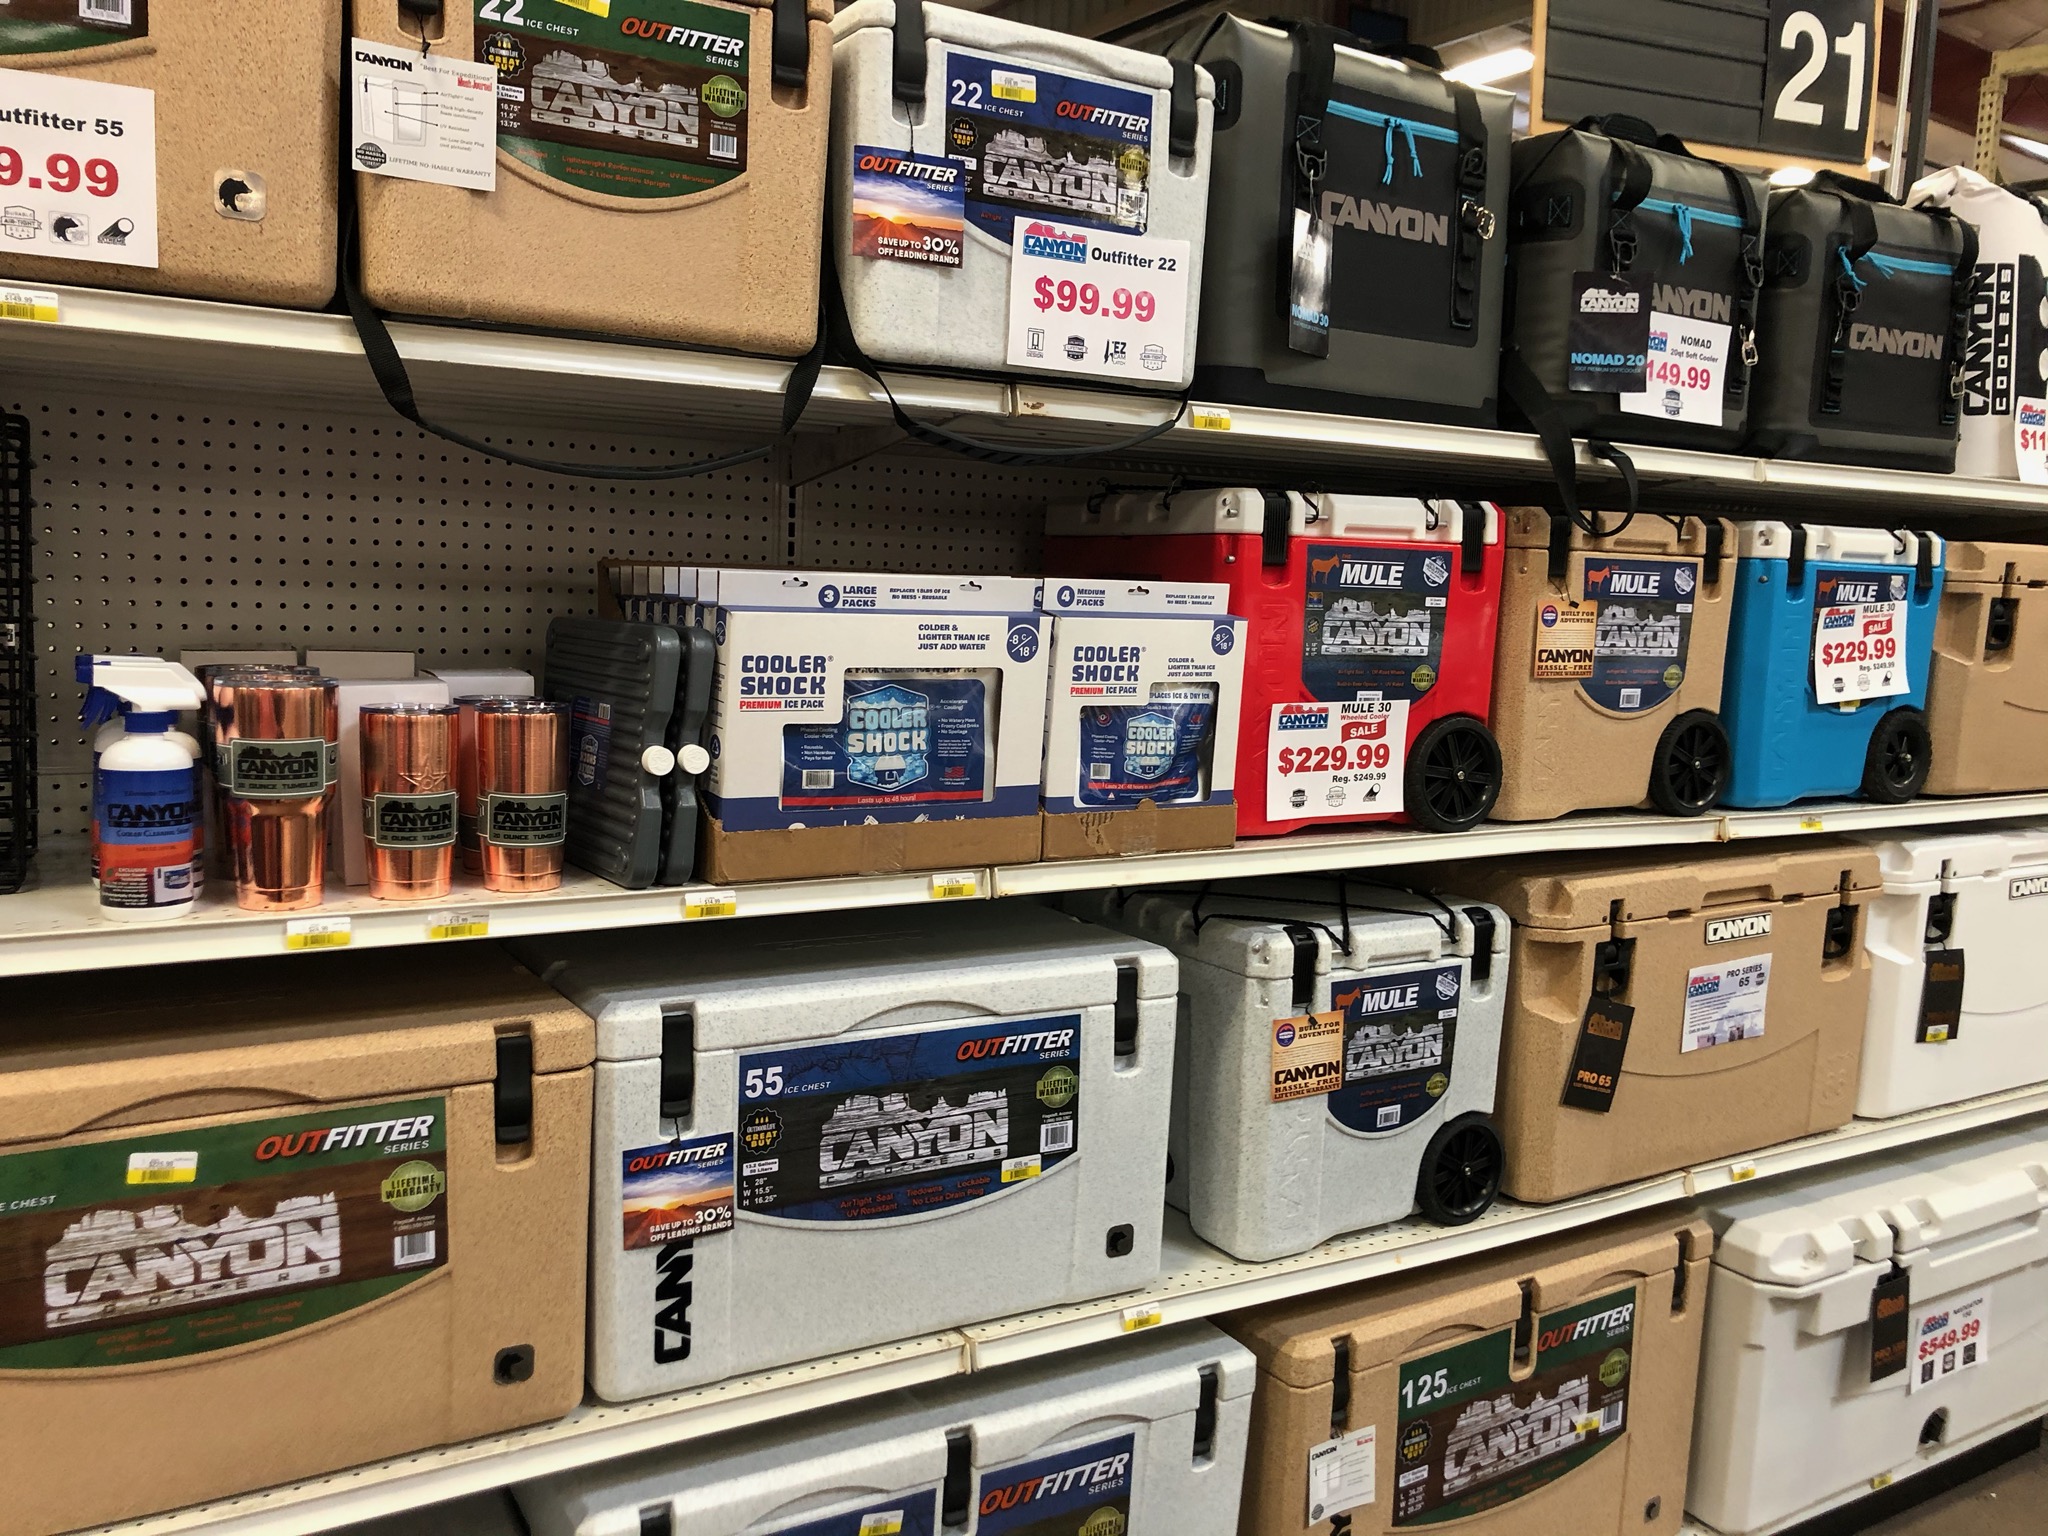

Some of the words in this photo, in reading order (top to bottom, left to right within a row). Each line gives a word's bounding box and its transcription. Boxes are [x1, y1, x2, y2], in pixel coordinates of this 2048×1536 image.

[526, 19, 542, 29] ICE
[546, 23, 579, 36] CHEST
[621, 18, 744, 57] OUTFITTER
[356, 51, 412, 71] CANYON
[706, 55, 739, 68] SERIES
[1773, 10, 1866, 132] 21
[709, 86, 740, 97] LIFETIME
[952, 79, 983, 109] 22
[531, 77, 698, 134] CANYON
[704, 93, 745, 108] WARRANTY
[984, 104, 997, 114] ICE
[999, 107, 1023, 117] CHEST
[1056, 100, 1149, 132] OUTFITTER
[95, 119, 123, 136] 55
[1122, 131, 1148, 142] SERIES
[860, 155, 958, 183] OUTFITTER
[984, 153, 1117, 204] CANYON
[927, 182, 953, 193] SERIES
[1321, 191, 1448, 246] CANYON
[878, 236, 898, 246] SAVE
[899, 239, 909, 248] UP
[911, 240, 921, 249] TO
[922, 236, 958, 255] 30%
[1025, 235, 1086, 257] CANYON
[878, 247, 893, 257] OFF
[894, 249, 928, 261] LEADING
[929, 254, 959, 265] BRANDS
[1092, 248, 1153, 268] Outfitter
[1158, 257, 1176, 271] 22
[1033, 275, 1155, 322] $99.99
[1581, 297, 1638, 309] CANYON
[1681, 335, 1712, 349] NOMAD
[1849, 322, 1943, 360] CANYON
[1996, 269, 2011, 410] COOLERS
[1571, 353, 1625, 365] NOMAD
[1627, 354, 1644, 366] 20
[1340, 565, 1404, 586] MULE
[1610, 574, 1660, 593] MULE
[824, 589, 835, 603] 3
[843, 586, 877, 595] LARGE
[1061, 589, 1070, 601] 4
[1836, 585, 1878, 602] MULE
[1076, 599, 1104, 607] PACKS
[1863, 604, 1884, 613] MULE
[1887, 603, 1895, 611] 30
[1322, 621, 1430, 645] CANYON
[1869, 621, 1887, 634] SALE
[1596, 626, 1680, 647] CANYON
[1074, 646, 1140, 662] COOLER
[1538, 649, 1593, 663] CANYON
[1822, 638, 1896, 668] $229.99
[742, 655, 826, 673] COOLER
[1072, 665, 1139, 682] SHOCK
[740, 676, 826, 695] SHOCK
[1070, 686, 1103, 695] PREMIUM
[1106, 686, 1117, 694] ICE
[1119, 686, 1137, 694] PACK
[740, 701, 781, 709] PREMIUM
[784, 700, 798, 709] ICE
[801, 699, 824, 709] PACK
[1341, 703, 1376, 714] MULE
[1378, 702, 1391, 713] 30
[851, 708, 927, 730] COOLER
[1279, 713, 1329, 725] CANYON
[1128, 727, 1174, 740] COOLER
[1350, 724, 1378, 738] SALE
[848, 731, 927, 753] SHOCK
[1126, 742, 1174, 755] SHOCK
[237, 758, 318, 774] CANYON
[1278, 743, 1390, 777] $229.99
[1332, 775, 1350, 784] Reg.
[1353, 773, 1386, 782] $249.99
[381, 812, 452, 827] CANYON
[493, 811, 562, 825] CANYON
[1708, 914, 1771, 942] CANYON
[1727, 969, 1740, 978] PRO
[1742, 964, 1762, 975] SERIES
[1689, 981, 1720, 994] CANYON
[1738, 977, 1749, 987] 65
[1362, 986, 1419, 1013] MULE
[1298, 1029, 1339, 1039] ADVENTURE
[956, 1028, 1074, 1061] OUTFITTER
[1346, 1035, 1443, 1071] CANYON
[1039, 1049, 1070, 1060] SERIES
[1274, 1060, 1340, 1085] CANYON
[1577, 1070, 1598, 1084] PRO
[1598, 1074, 1612, 1087] 65
[744, 1066, 784, 1098] 55
[784, 1085, 800, 1094] ICE
[802, 1081, 831, 1092] CHEST
[1043, 1077, 1073, 1089] LIFETIME
[255, 1114, 434, 1161] OUTFITTER
[746, 1131, 777, 1141] GREAT
[751, 1139, 771, 1147] BUY
[820, 1108, 1008, 1172] CANYON
[383, 1139, 430, 1155] SERIES
[629, 1142, 727, 1173] OUTFITTER
[697, 1158, 724, 1170] SERIES
[391, 1174, 435, 1189] LIFETIME
[906, 1184, 943, 1196] Tiedowns
[957, 1176, 991, 1188] Lockable
[386, 1183, 441, 1199] WARRANTY
[11, 1195, 56, 1210] CHEST
[650, 1222, 669, 1233] SAVE
[670, 1221, 680, 1230] UP
[682, 1219, 693, 1227] TO
[695, 1206, 732, 1224] 30%
[650, 1233, 665, 1243] OFF
[667, 1227, 700, 1239] LEADING
[702, 1219, 732, 1232] BRANDS
[45, 1214, 340, 1308] CANYON
[1537, 1303, 1634, 1351] OUTFITTER
[1607, 1324, 1630, 1337] SERIES
[1918, 1319, 1980, 1361] $549.99
[1402, 1368, 1447, 1408] 125
[1447, 1386, 1457, 1394] ICE
[1459, 1377, 1481, 1389] CHEST
[1445, 1390, 1588, 1480] CANYON
[1312, 1445, 1337, 1460] CANYON
[980, 1452, 1130, 1516] OUTFITTER
[1088, 1476, 1124, 1496] SERIES
